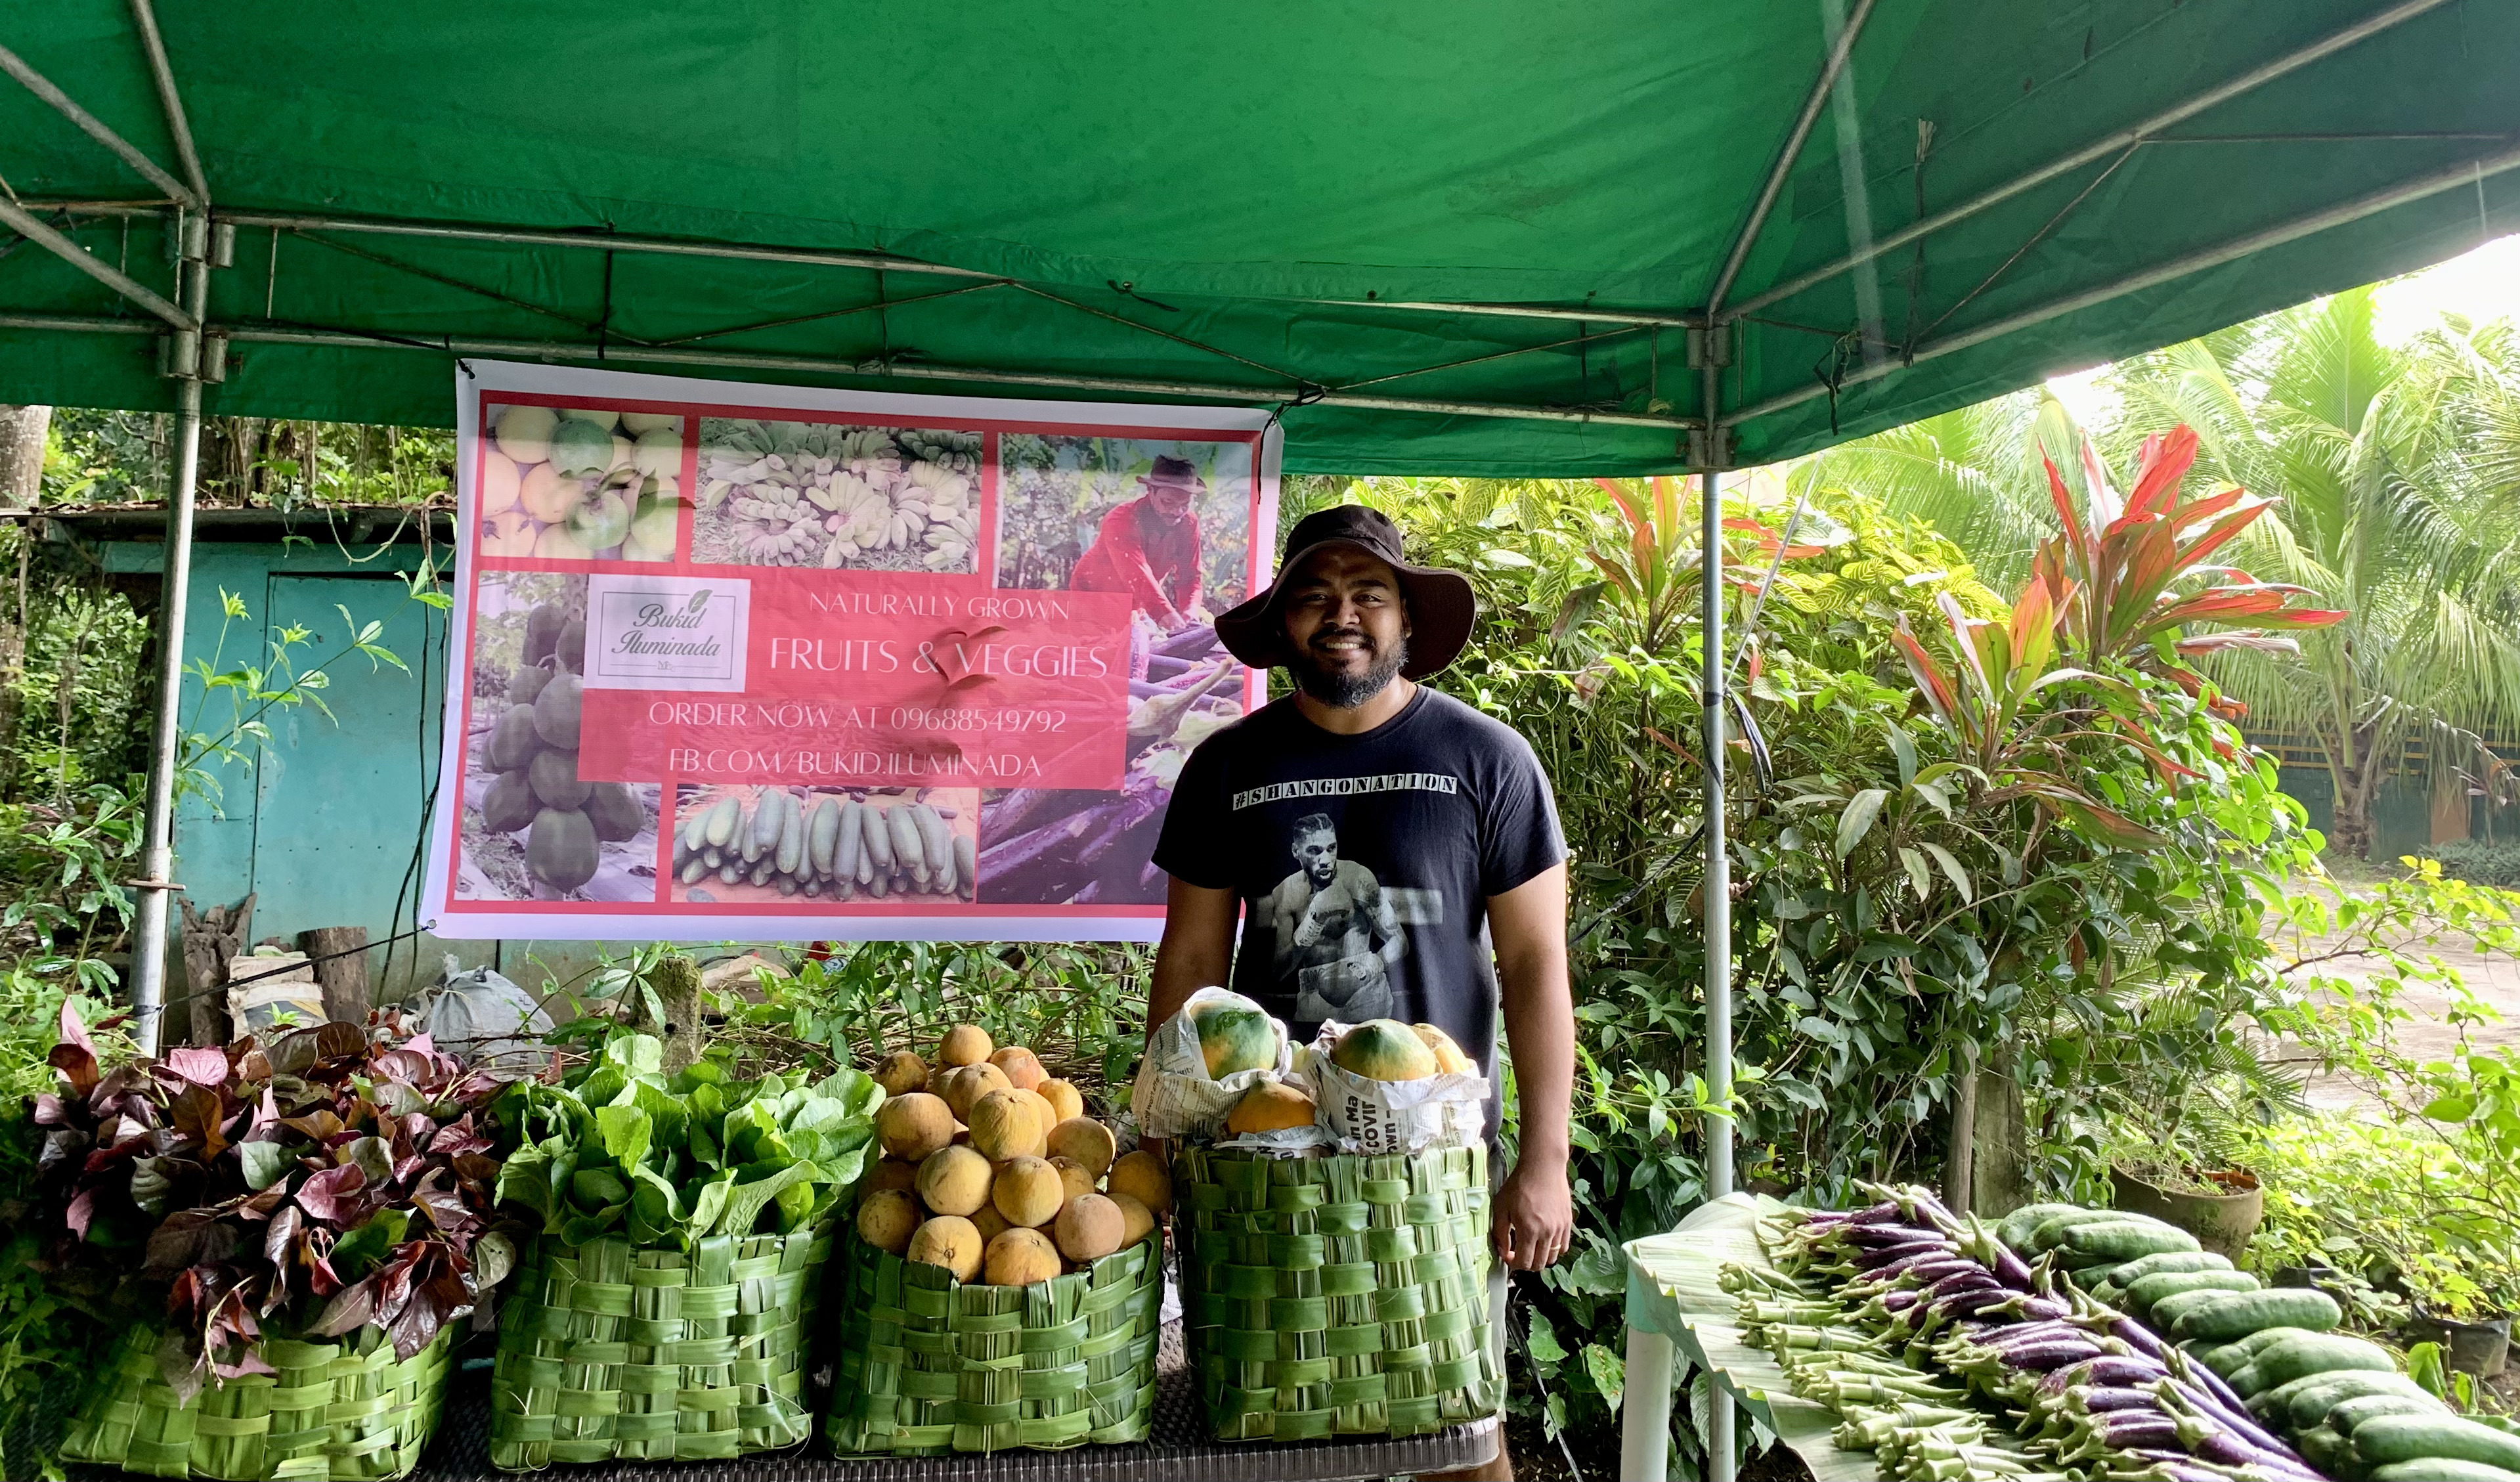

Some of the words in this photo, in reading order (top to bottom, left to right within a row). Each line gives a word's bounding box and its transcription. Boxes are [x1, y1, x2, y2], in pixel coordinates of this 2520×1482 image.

[633, 603, 707, 628] Bukid
[810, 592, 959, 617] NATURALLY
[967, 597, 1070, 621] GROWN
[611, 630, 722, 656] Iluminada
[770, 637, 898, 673] FRUITS
[912, 641, 940, 674] &
[955, 642, 1108, 679] VEGGIES
[649, 701, 747, 726] ORDER
[757, 704, 834, 728] NOW
[843, 707, 882, 729] AT
[891, 707, 1066, 733] 09688549792
[669, 747, 1041, 777] FB.COM/BUKID.ILUMINADA
[1233, 773, 1458, 810] #SHANGONATION
